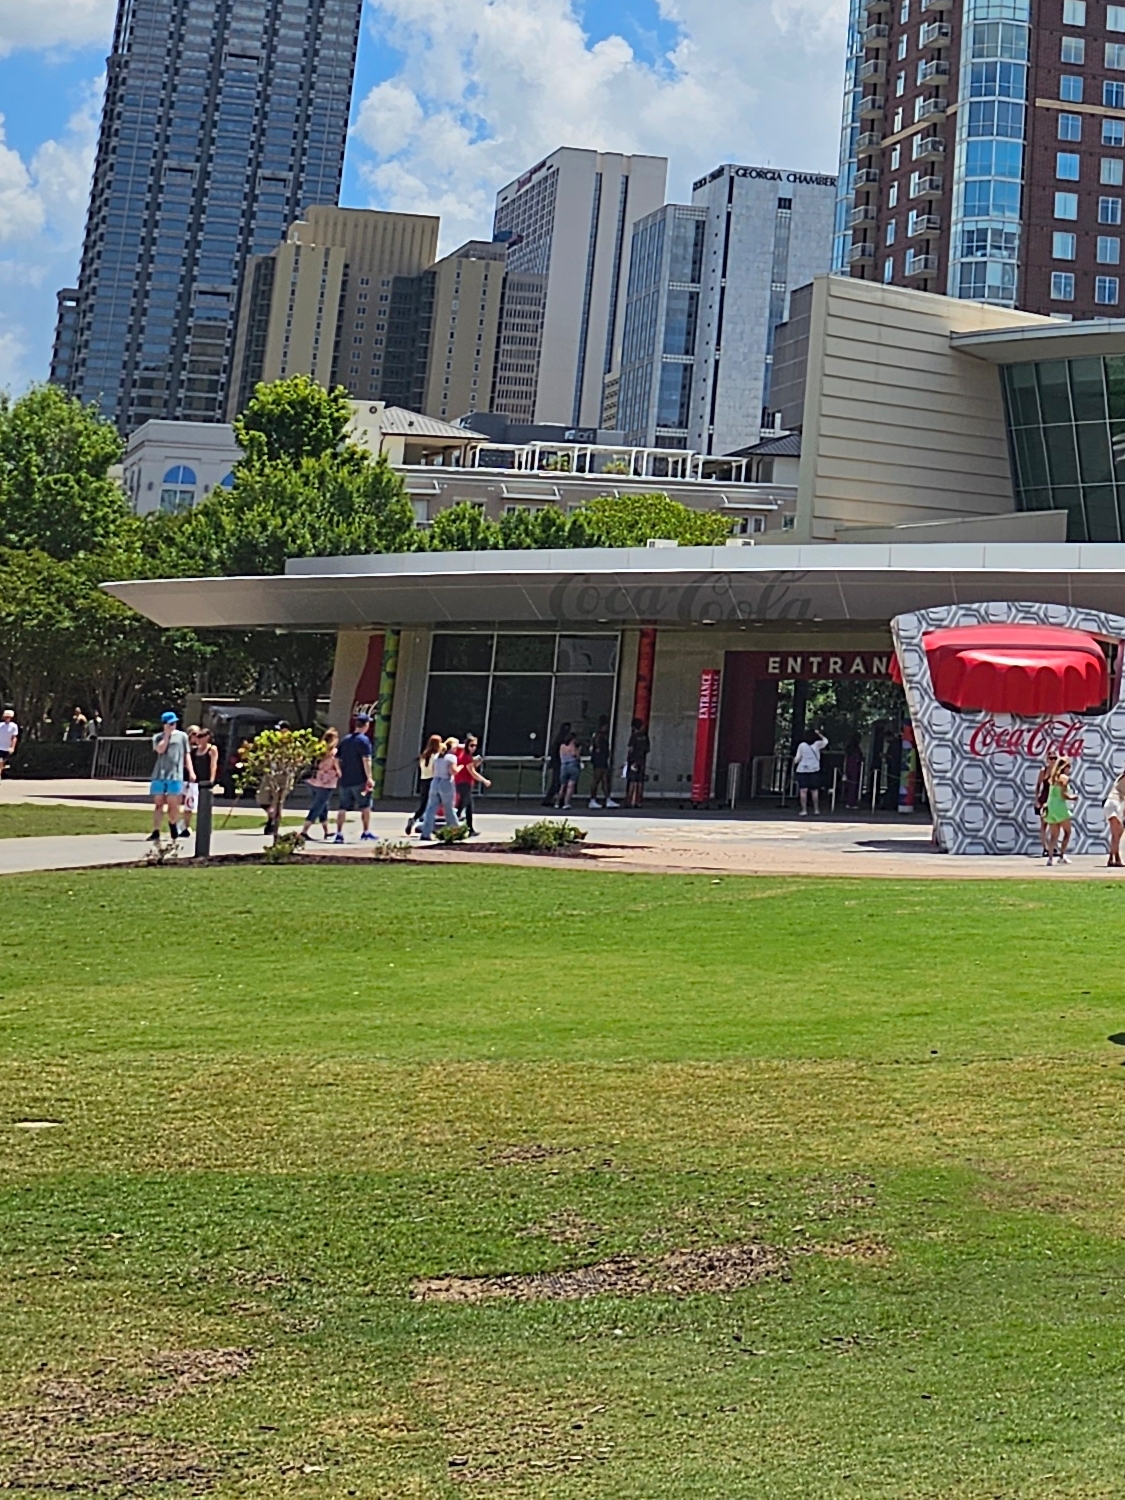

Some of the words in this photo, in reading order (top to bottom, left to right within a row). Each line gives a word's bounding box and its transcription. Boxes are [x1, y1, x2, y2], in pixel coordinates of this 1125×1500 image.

[735, 167, 782, 182] GEORGIA
[786, 173, 837, 187] CHAMBER
[550, 572, 812, 621] Coca-Cola
[768, 657, 887, 674] ENTRAN
[699, 674, 711, 718] ENTRANCE
[970, 719, 1086, 757] Coca-Cola
